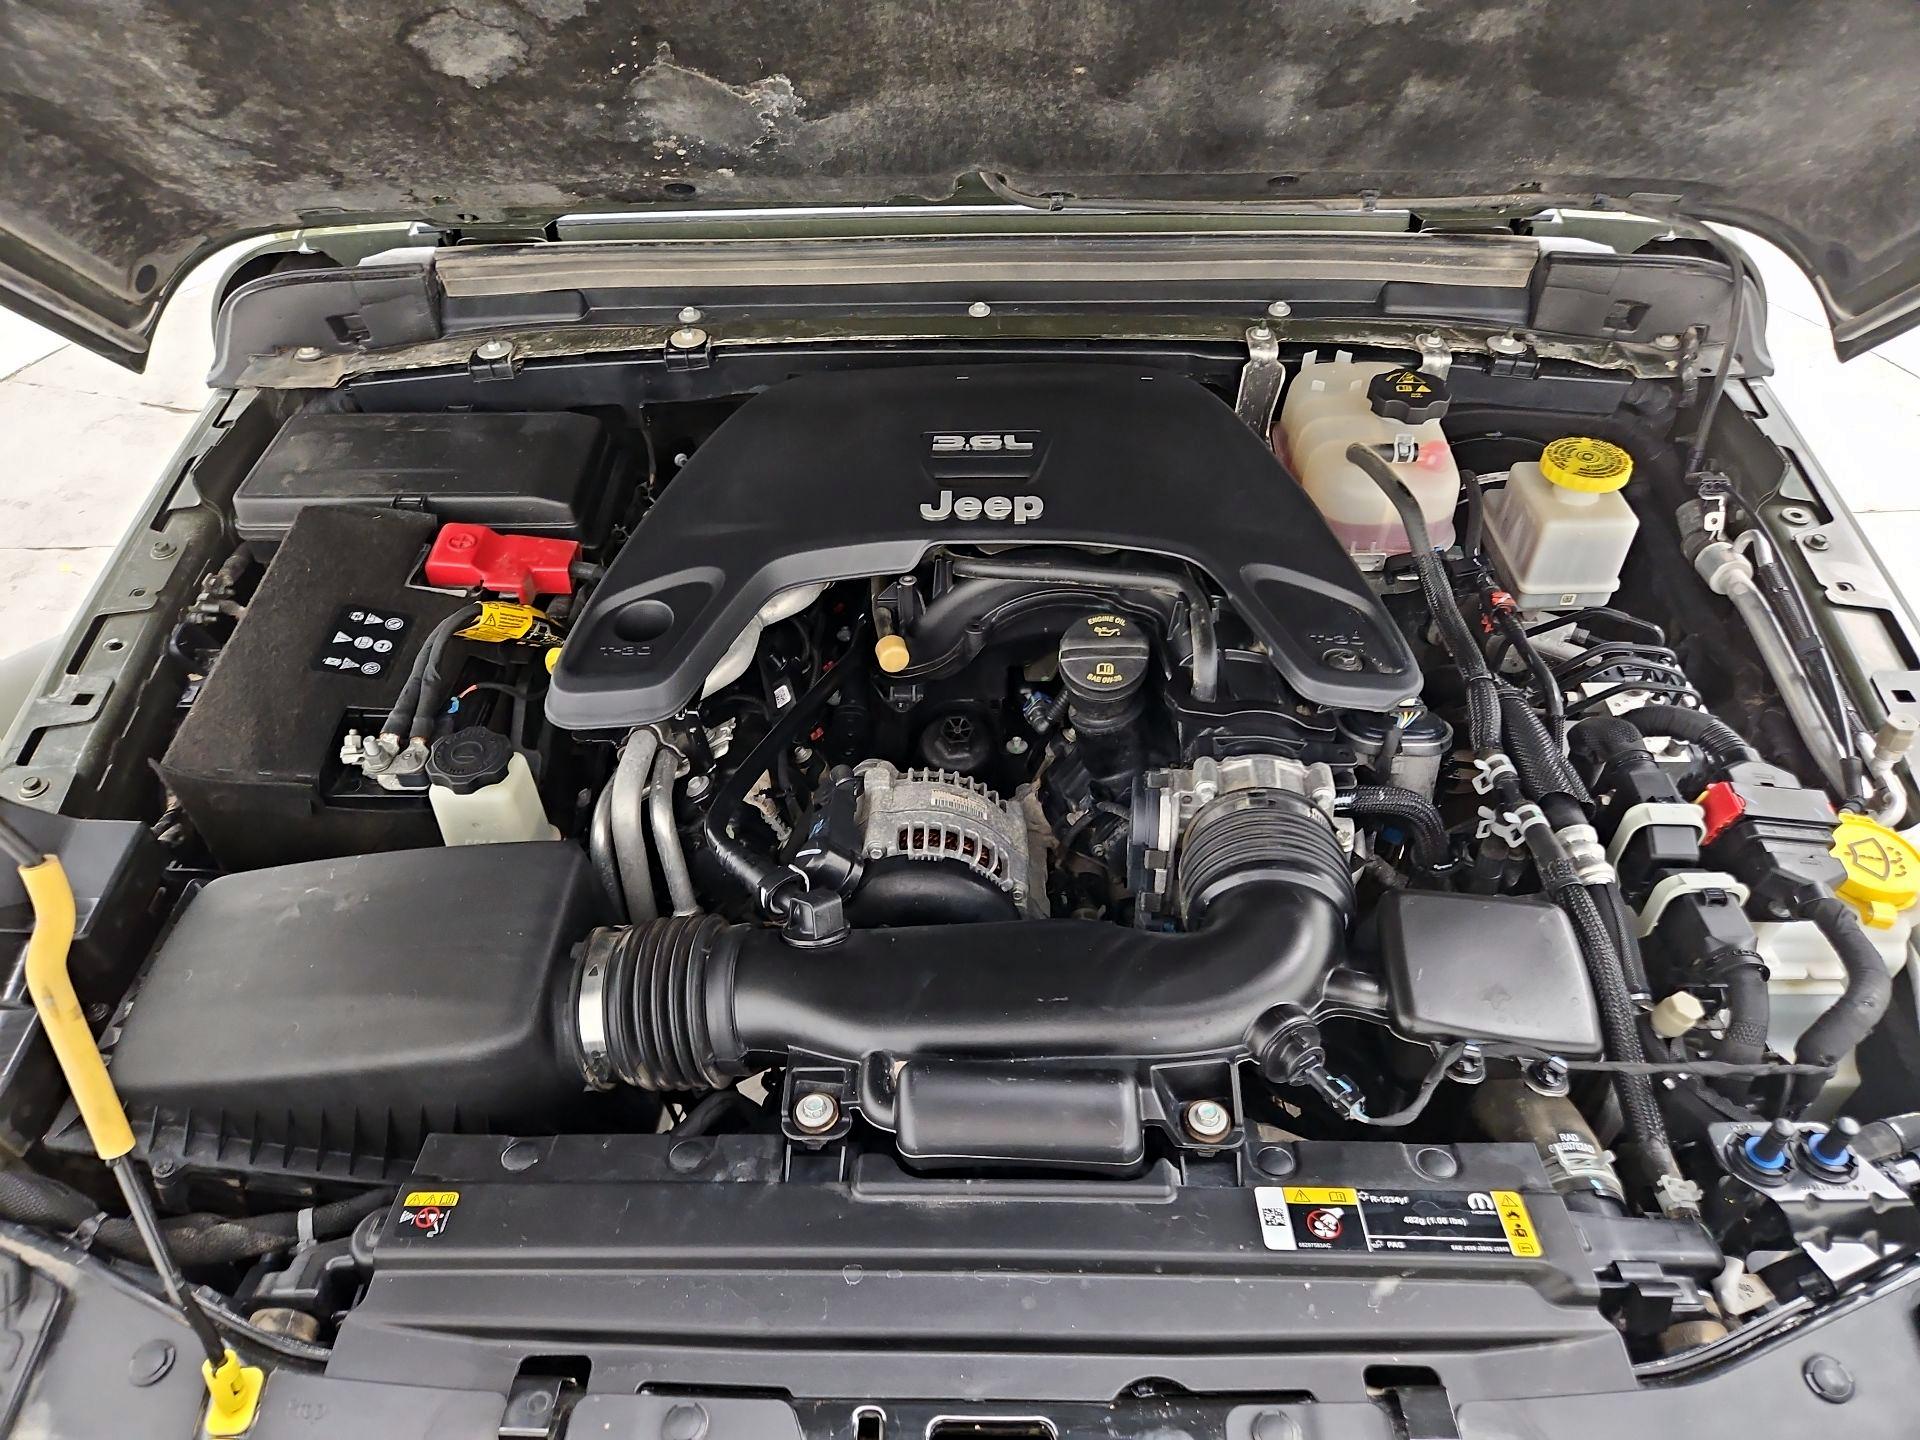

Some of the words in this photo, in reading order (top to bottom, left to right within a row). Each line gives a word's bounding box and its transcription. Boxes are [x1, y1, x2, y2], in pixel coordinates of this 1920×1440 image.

[932, 434, 1033, 451] 3.6L
[920, 490, 1044, 525] Jeep
[1087, 615, 1114, 625] ENGINE
[1115, 617, 1126, 626] OIL
[1558, 1133, 1579, 1141] RAD
[1386, 1241, 1406, 1249] PAG
